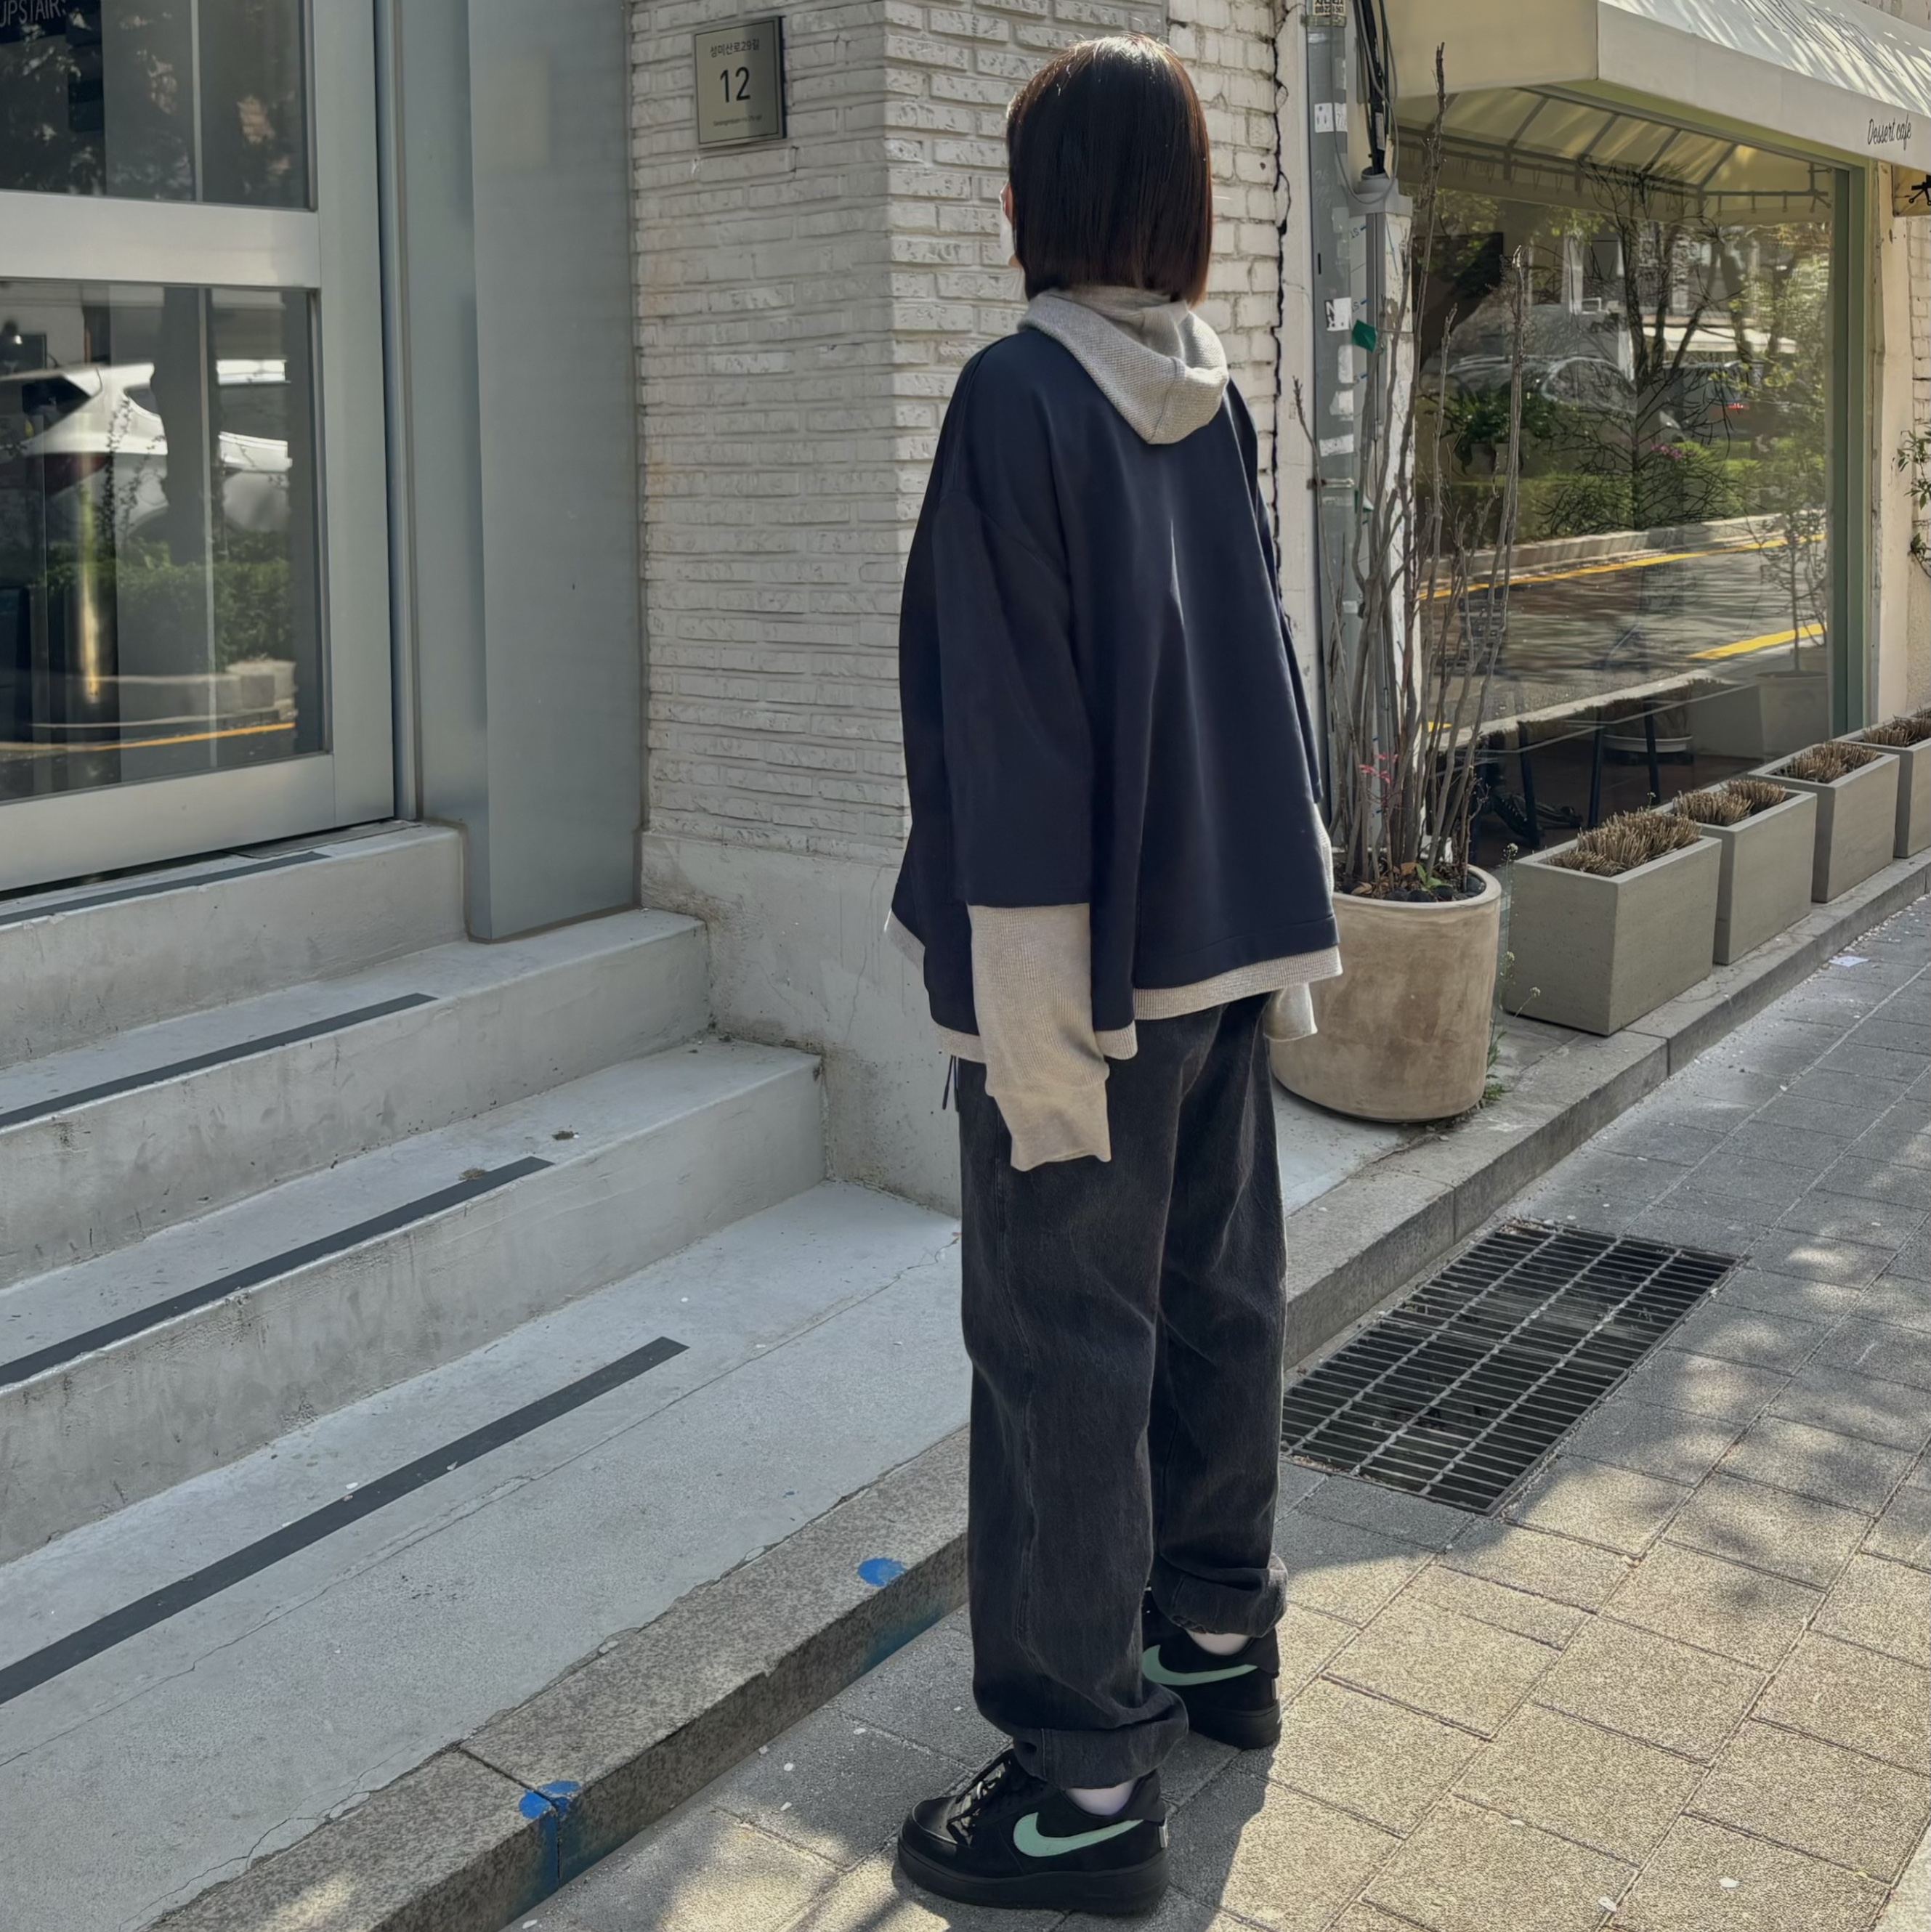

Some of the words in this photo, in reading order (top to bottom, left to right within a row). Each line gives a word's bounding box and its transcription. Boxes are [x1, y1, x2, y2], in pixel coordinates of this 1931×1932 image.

[720, 67, 751, 103] 12
[1867, 118, 1895, 145] Dessert
[1896, 113, 1912, 151] cafe
